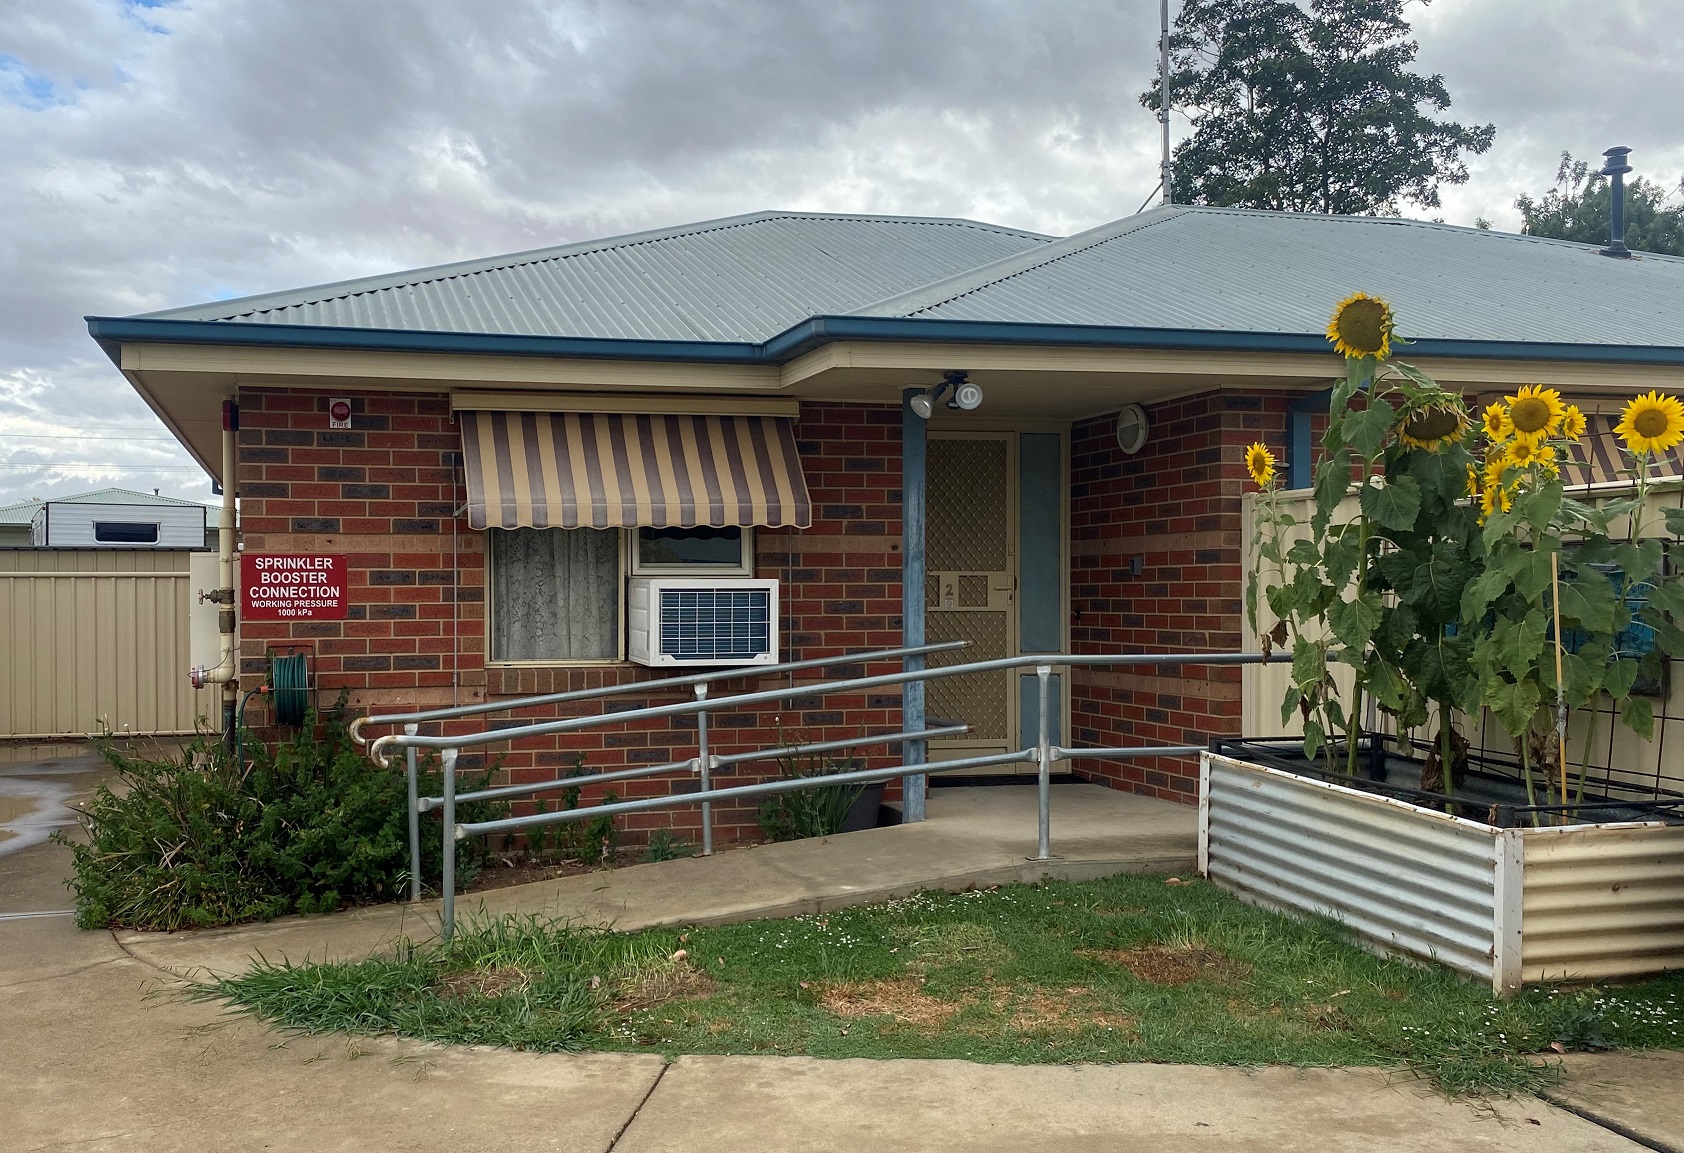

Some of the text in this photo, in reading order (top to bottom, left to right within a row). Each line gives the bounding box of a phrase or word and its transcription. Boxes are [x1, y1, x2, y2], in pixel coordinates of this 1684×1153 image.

[255, 558, 333, 569] SPRINKLER
[261, 572, 327, 583] BOOSTER
[250, 586, 339, 598] CONNECTION
[945, 584, 953, 596] 2
[251, 600, 292, 608] WORKING
